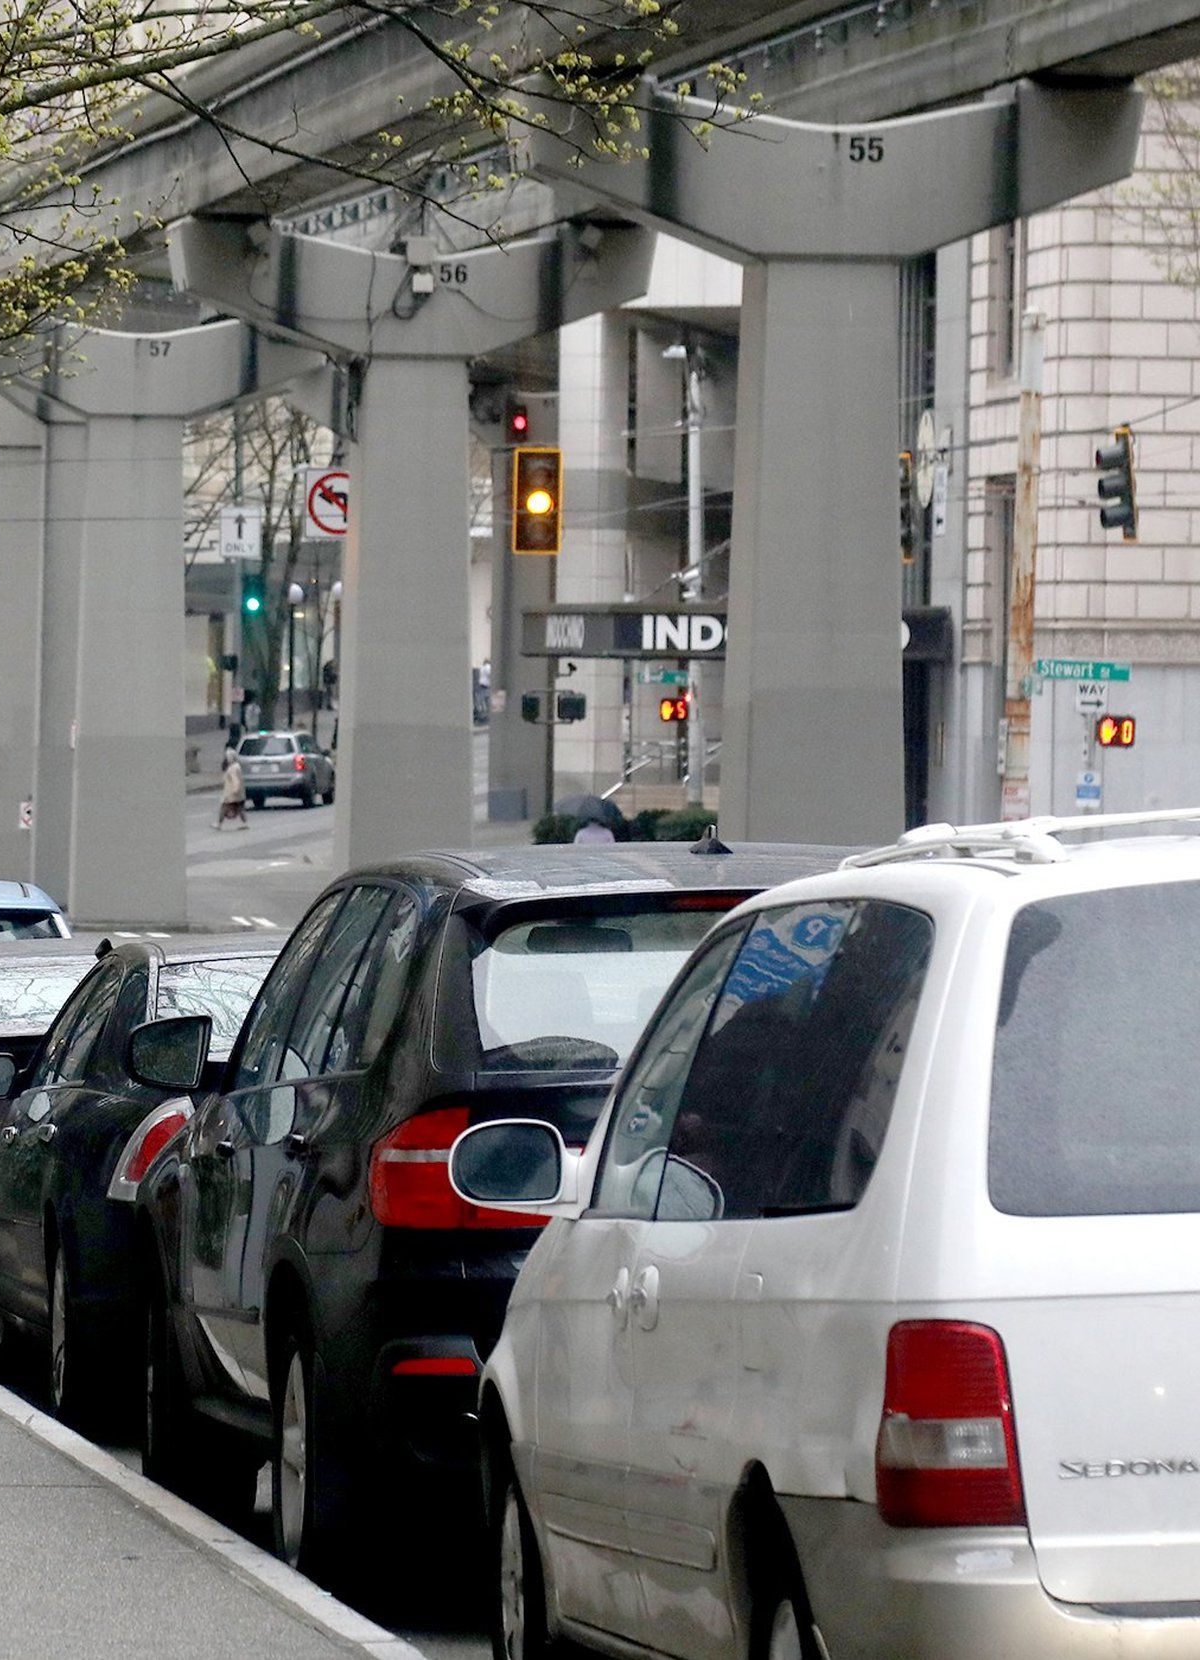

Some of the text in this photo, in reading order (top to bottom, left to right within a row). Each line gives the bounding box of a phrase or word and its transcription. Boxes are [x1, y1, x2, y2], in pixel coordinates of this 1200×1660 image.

[850, 137, 883, 162] 55
[440, 263, 467, 283] 56
[150, 341, 170, 357] 57
[226, 543, 256, 552] ONLY
[642, 615, 727, 651] IND
[1041, 661, 1094, 677] Stewart
[1079, 684, 1106, 695] WAY
[677, 701, 687, 719] 5
[1121, 719, 1134, 745] 0
[1059, 1460, 1199, 1480] SEDONA
